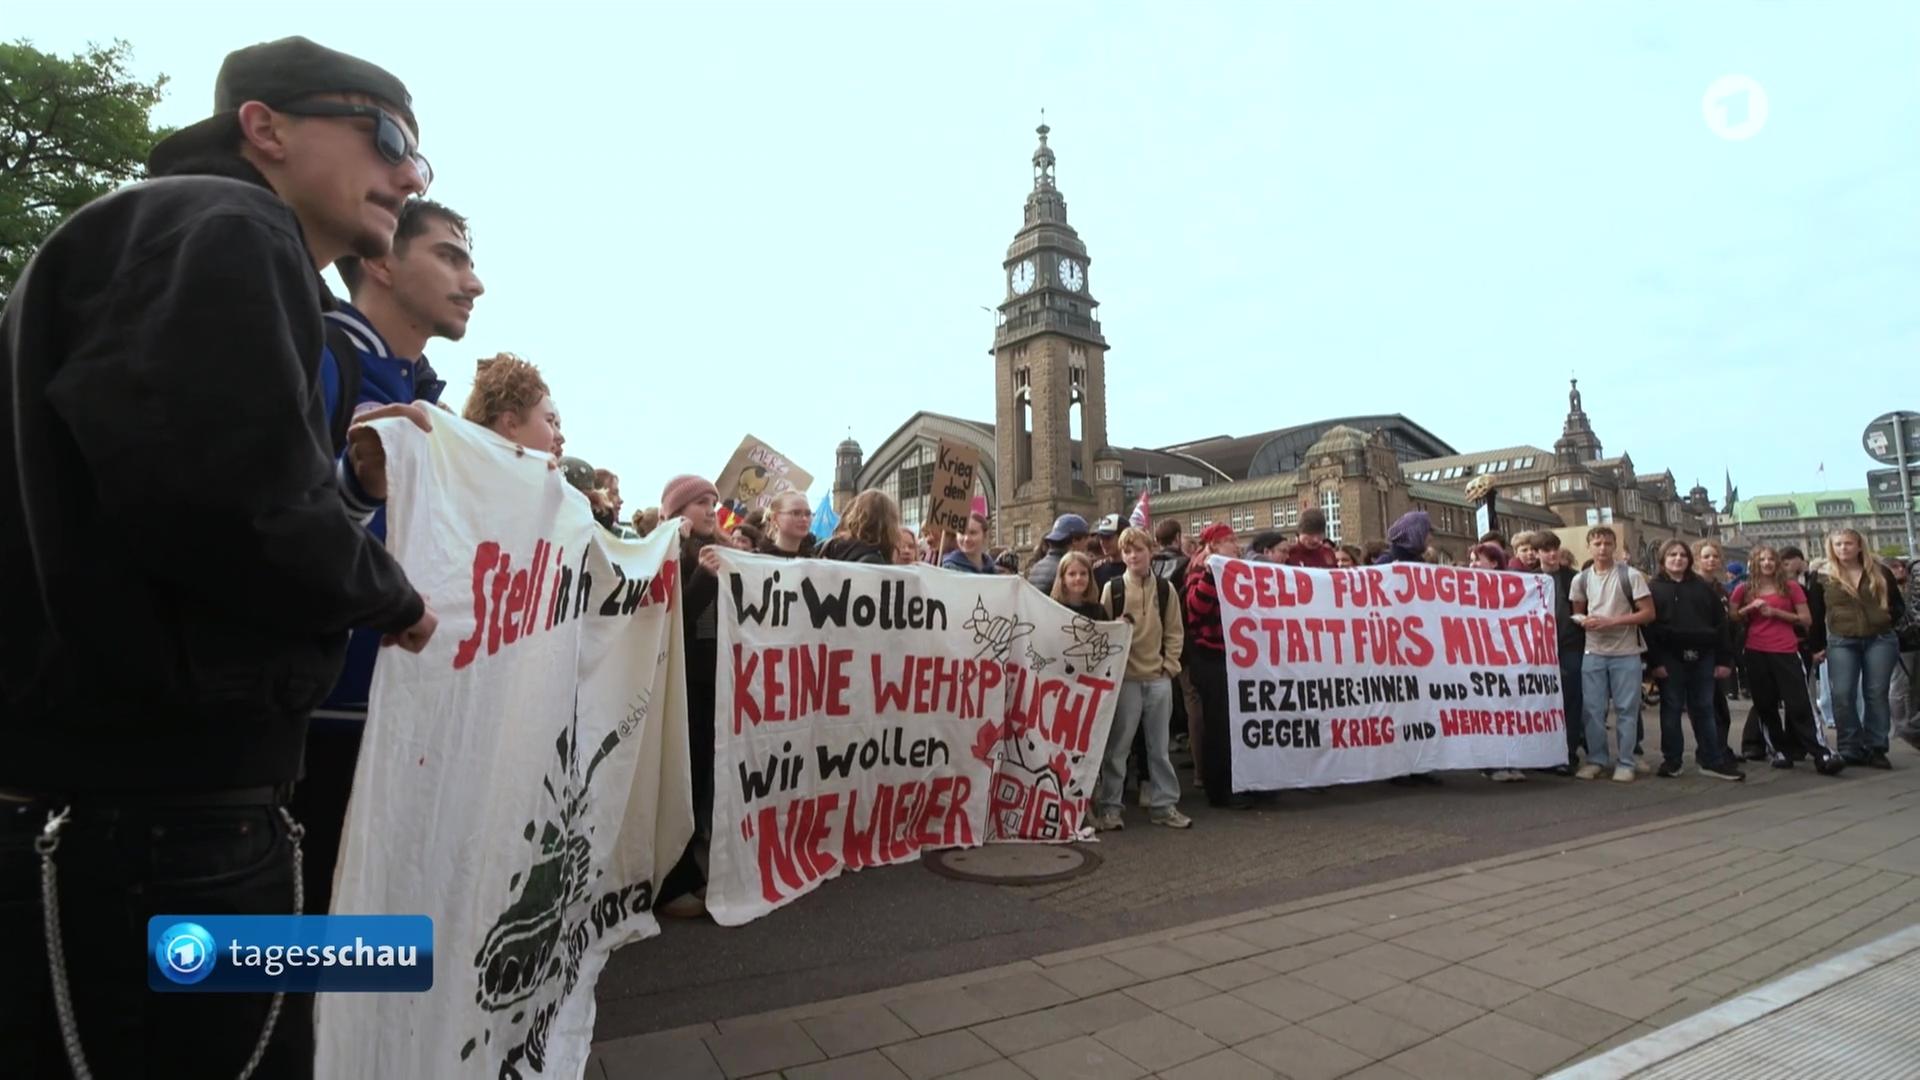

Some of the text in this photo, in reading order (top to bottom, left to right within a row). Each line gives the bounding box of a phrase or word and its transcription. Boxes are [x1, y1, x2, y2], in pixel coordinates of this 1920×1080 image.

[939, 445, 973, 490] Krieg
[944, 476, 966, 502] dem
[930, 497, 967, 535] Krieg
[730, 570, 947, 631] Wir Wollen
[1221, 560, 1314, 609] GELD
[1392, 564, 1526, 609] JUGEND
[1229, 609, 1558, 668] STATT FÜRS MILITÄR
[733, 644, 854, 735] KEINE
[1238, 671, 1559, 713] ERZIEHER:INNEN UND SPA AZUBIS
[816, 726, 949, 781] wollen
[1241, 718, 1321, 749] GEGEN
[1331, 715, 1395, 748] KRIEG
[1402, 722, 1436, 742] UND
[842, 775, 974, 870] WIEDER
